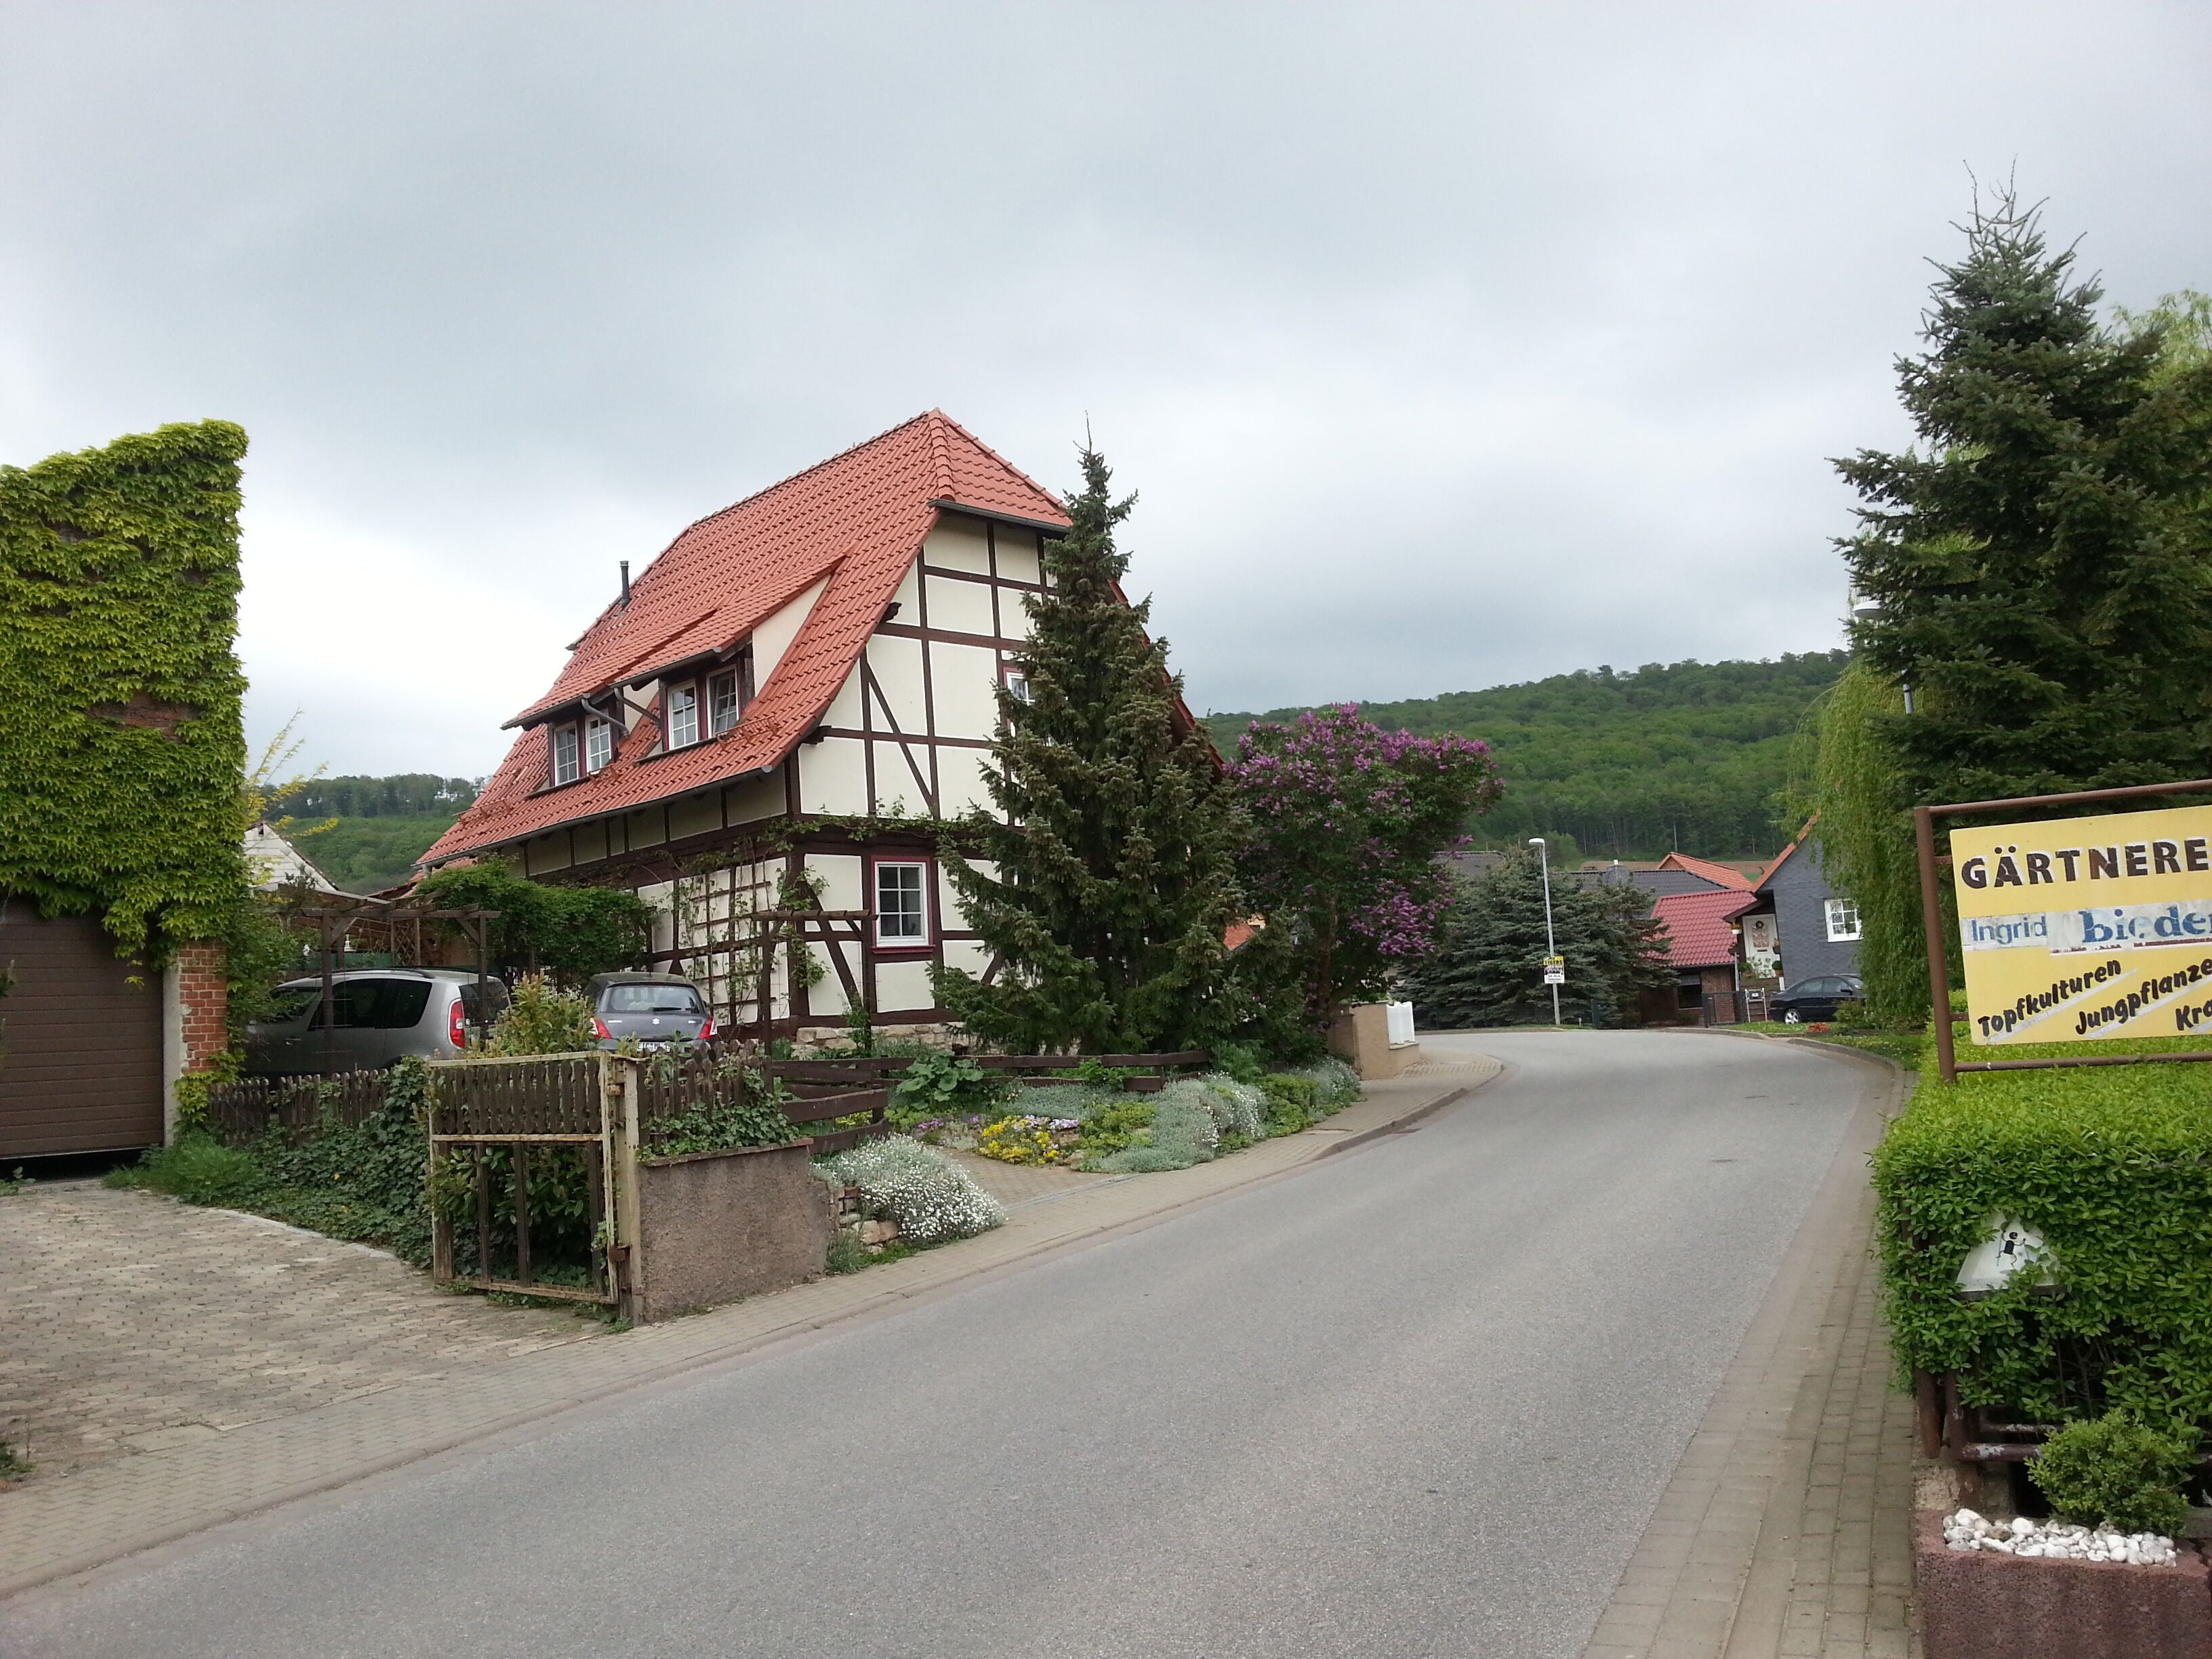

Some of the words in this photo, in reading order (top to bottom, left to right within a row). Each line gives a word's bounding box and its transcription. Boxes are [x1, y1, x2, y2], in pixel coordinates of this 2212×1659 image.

[1971, 916, 2048, 945] Ingrid
[2078, 905, 2212, 943] biede
[1978, 959, 2122, 1036] Topfkulturen
